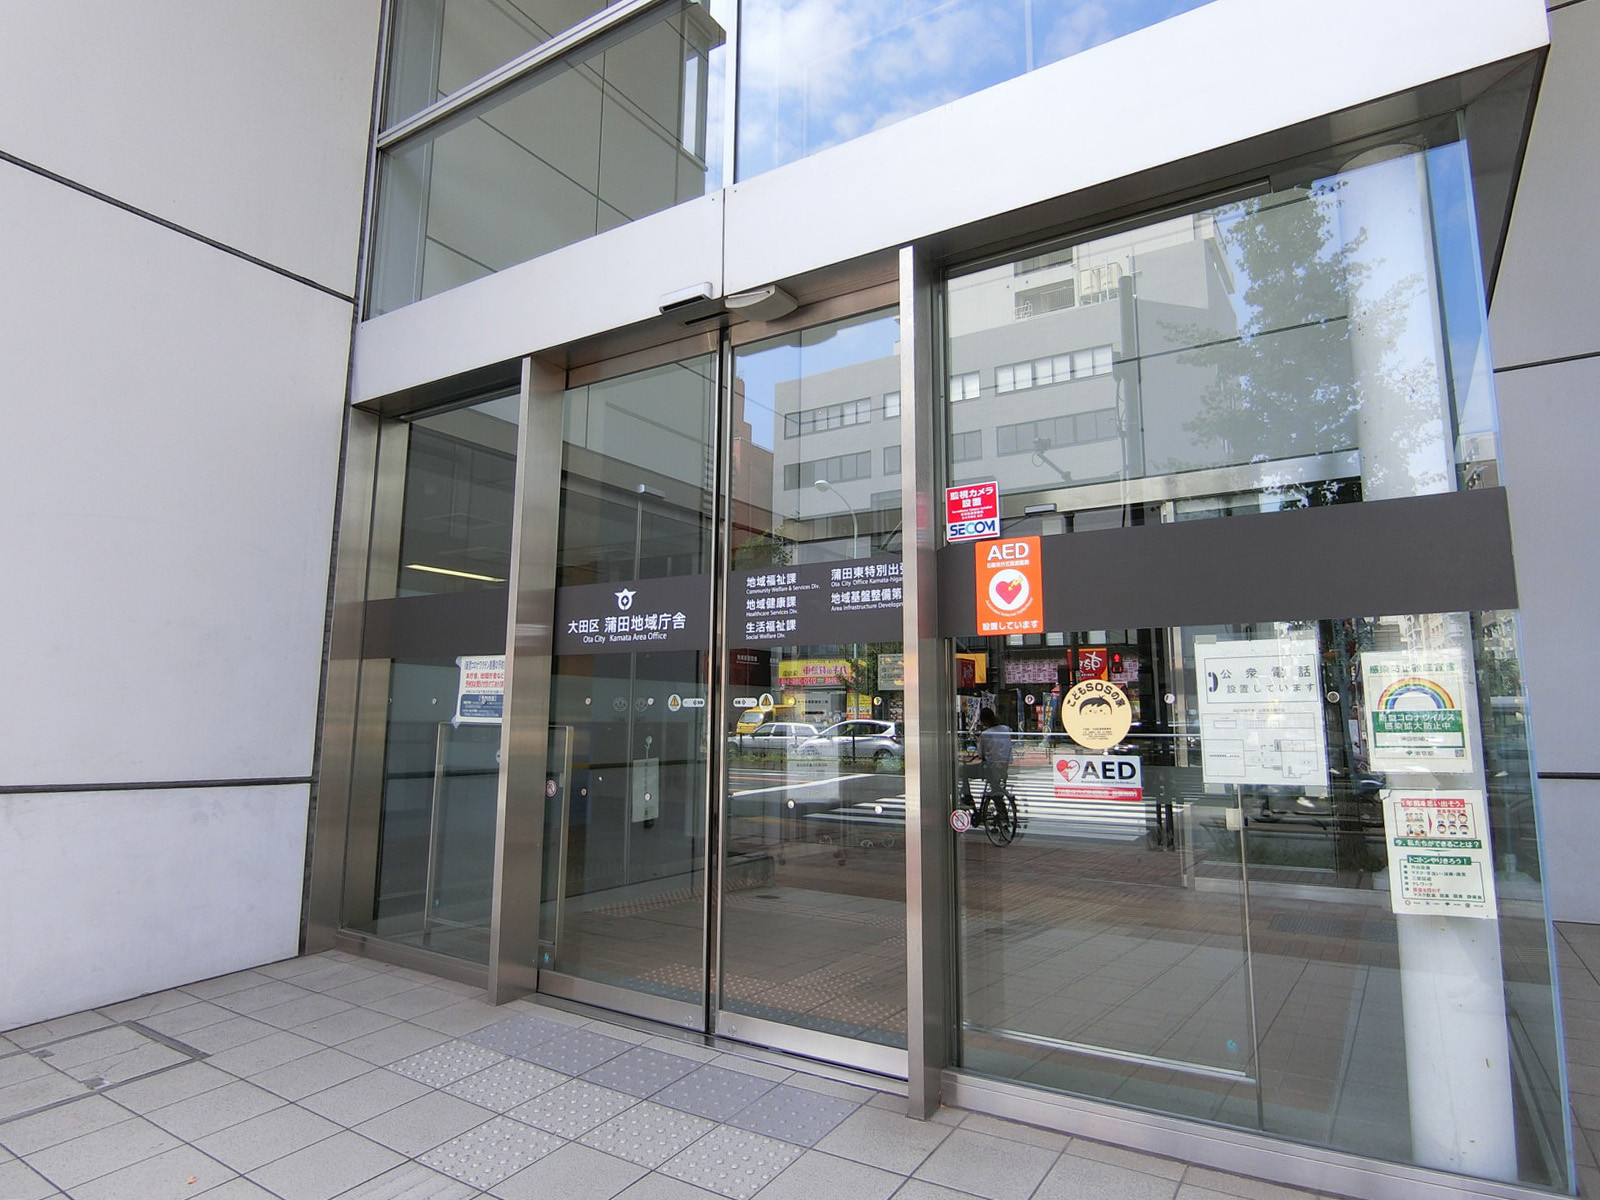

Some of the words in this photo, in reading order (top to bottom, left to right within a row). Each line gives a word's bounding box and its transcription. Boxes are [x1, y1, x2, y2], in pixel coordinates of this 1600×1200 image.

[950, 487, 994, 501] 監視カメラ
[962, 497, 982, 508] 設置
[950, 520, 996, 536] SECOM
[987, 542, 1030, 561] AED
[746, 573, 797, 588] 地域福祉課
[842, 580, 851, 588] City
[852, 579, 868, 587] Office
[792, 584, 811, 592] Services
[831, 587, 902, 604] 地域基盤整備第
[746, 596, 797, 611] 地域健康課
[843, 602, 878, 612] Infrastructure
[769, 609, 789, 617] Services
[568, 619, 600, 634] 大田区
[604, 611, 687, 634] 蒲田地域庁舎
[746, 619, 797, 634] 生活福祉課
[982, 620, 1039, 631] 設置しています
[583, 635, 593, 643] Ota
[594, 634, 606, 644] City
[609, 634, 632, 642] Kamata
[632, 633, 647, 641] Area
[648, 631, 668, 641] Office
[1220, 665, 1311, 679] 公衆電話
[1227, 683, 1315, 694] 設置しています
[1378, 711, 1456, 723] 新型コロナウイルス
[1384, 722, 1451, 730] 感染拡大防止中
[1081, 761, 1137, 780] AED
